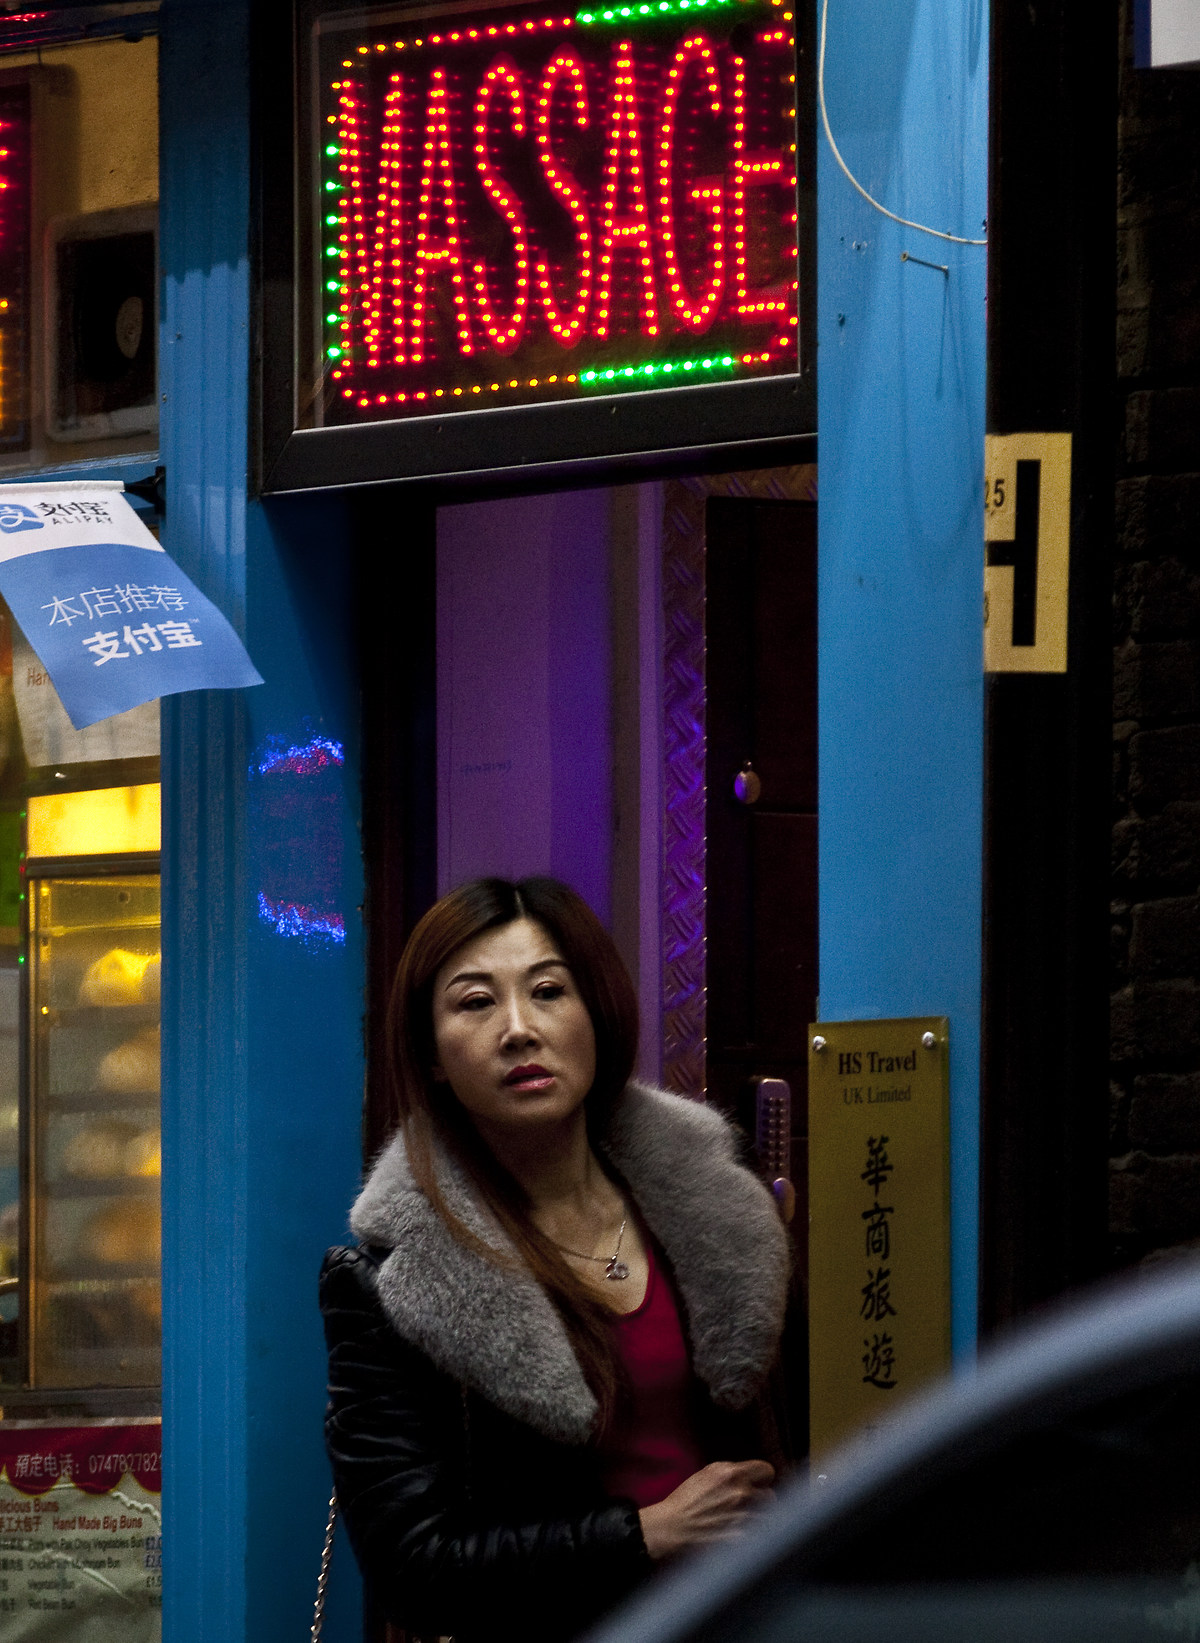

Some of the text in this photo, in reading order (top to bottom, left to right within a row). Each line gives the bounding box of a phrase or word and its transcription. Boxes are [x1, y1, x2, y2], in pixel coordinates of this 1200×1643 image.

[338, 31, 788, 368] MASSAGE
[52, 515, 113, 525] ALIPAY
[41, 583, 189, 628] 本店推荐
[82, 620, 203, 666] 支付宝
[838, 1050, 917, 1075] HS Travel
[844, 1085, 912, 1105] UK Limited
[860, 1135, 898, 1390] 華商旅遊
[89, 1452, 162, 1474] 074782782
[34, 1498, 59, 1512] Buns
[53, 1515, 143, 1532] Hand Made Big Buns
